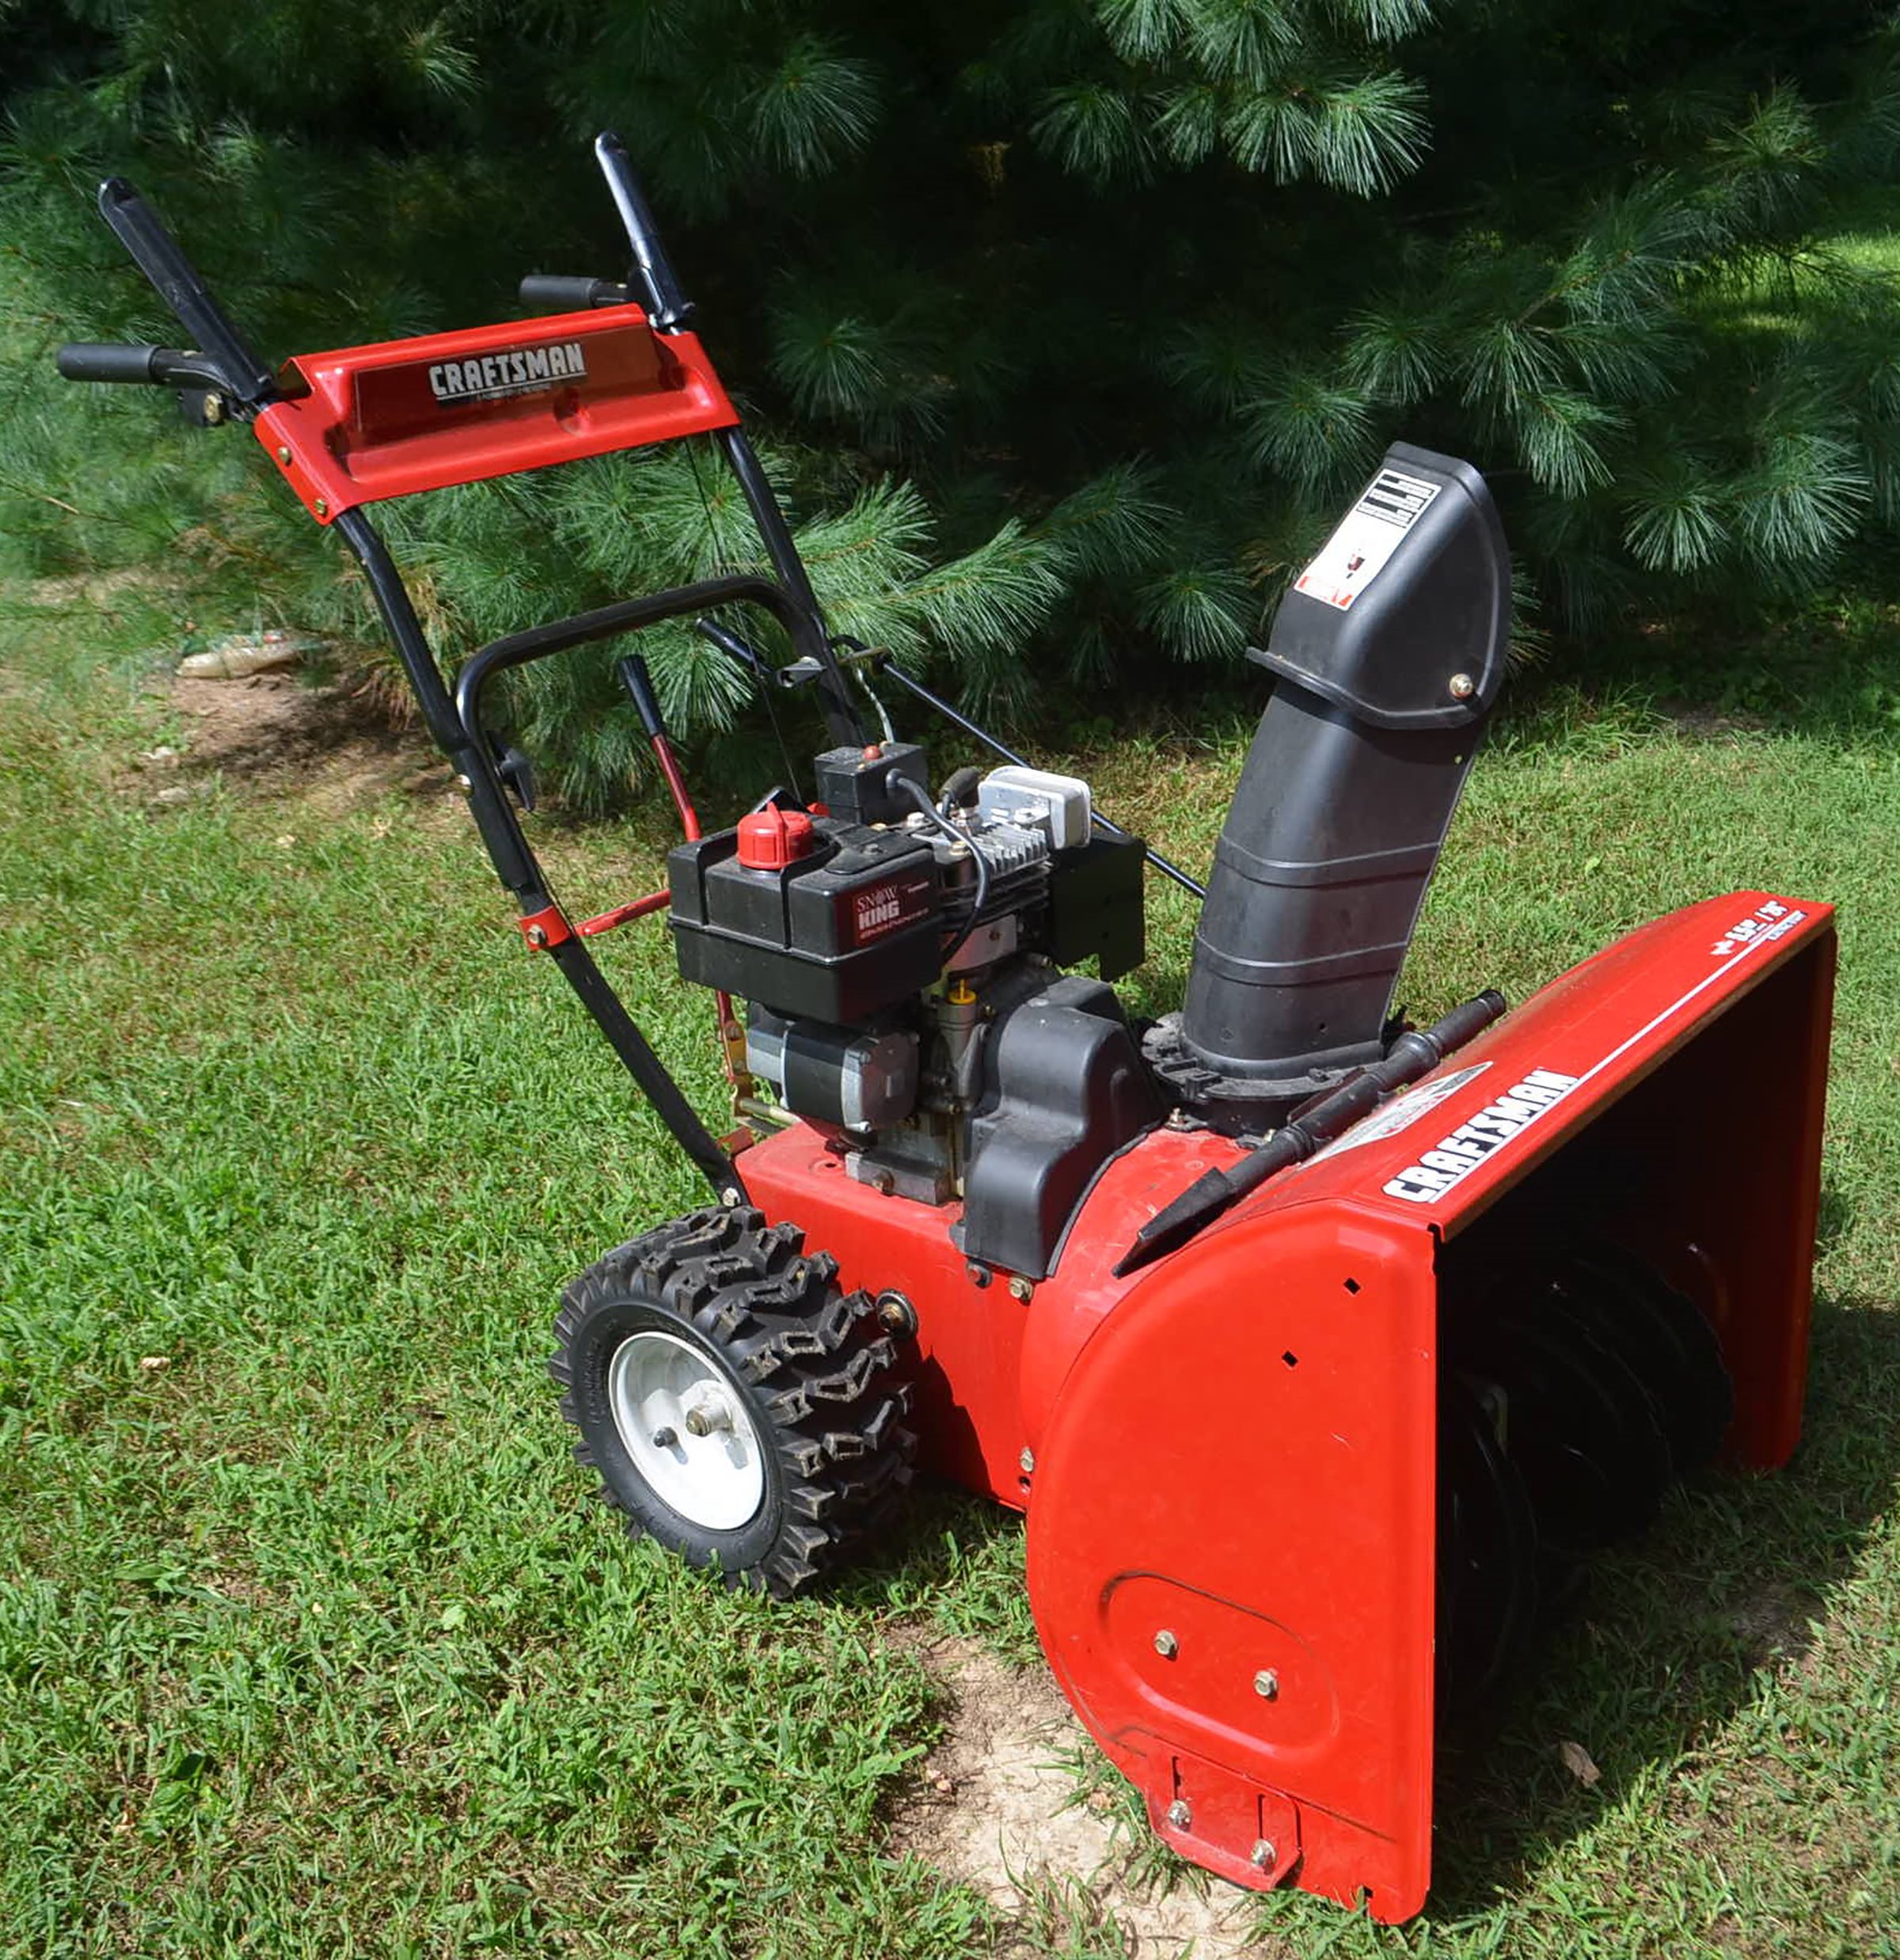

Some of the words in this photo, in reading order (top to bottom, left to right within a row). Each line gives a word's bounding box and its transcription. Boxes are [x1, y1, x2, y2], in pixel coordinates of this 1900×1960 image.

[428, 343, 585, 396] CRAFTSMAN
[857, 883, 898, 911] SNOW
[858, 900, 899, 930] KING
[1382, 1066, 1580, 1202] CRAFTSMAN
